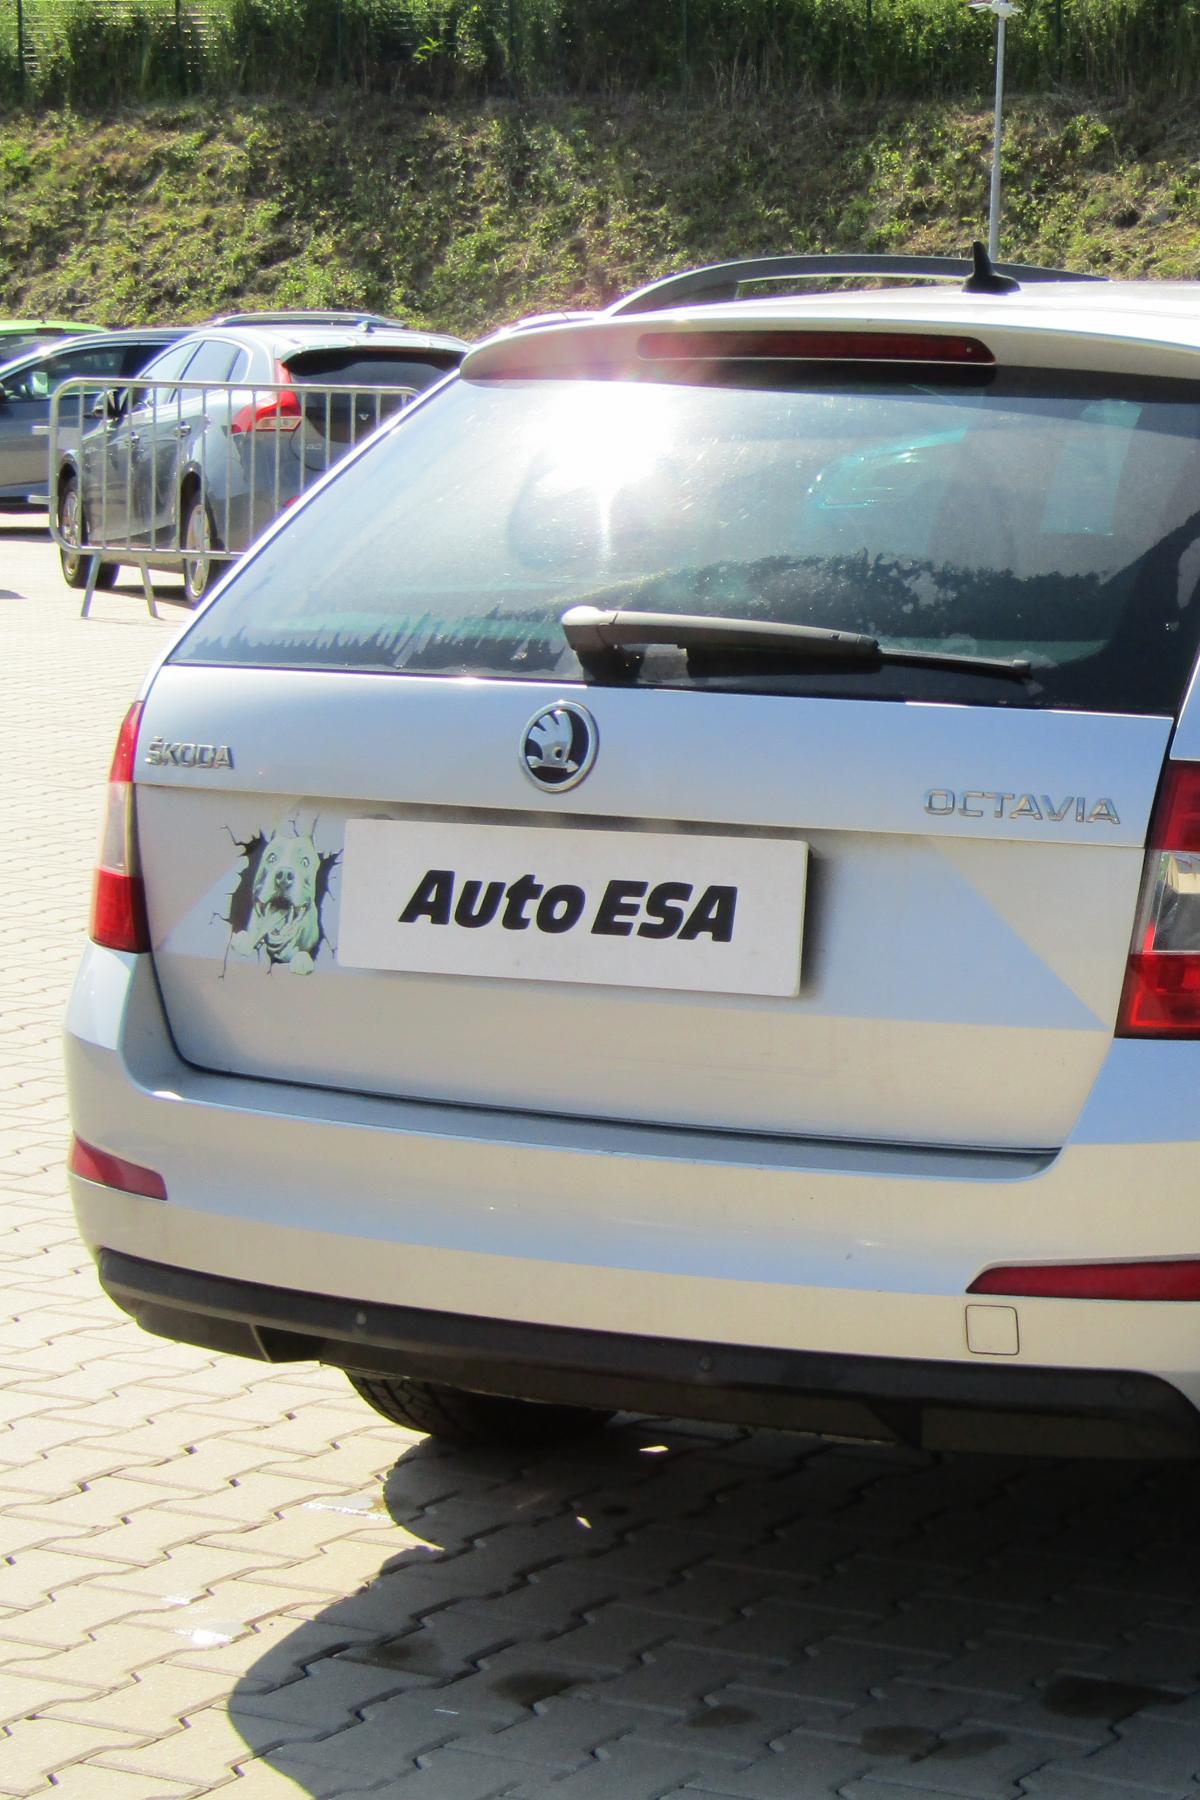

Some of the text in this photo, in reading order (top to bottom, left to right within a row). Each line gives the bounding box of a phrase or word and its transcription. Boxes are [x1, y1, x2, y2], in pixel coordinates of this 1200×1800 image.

[923, 787, 1121, 825] OCTAVIA
[398, 869, 738, 943] Auto ESA
